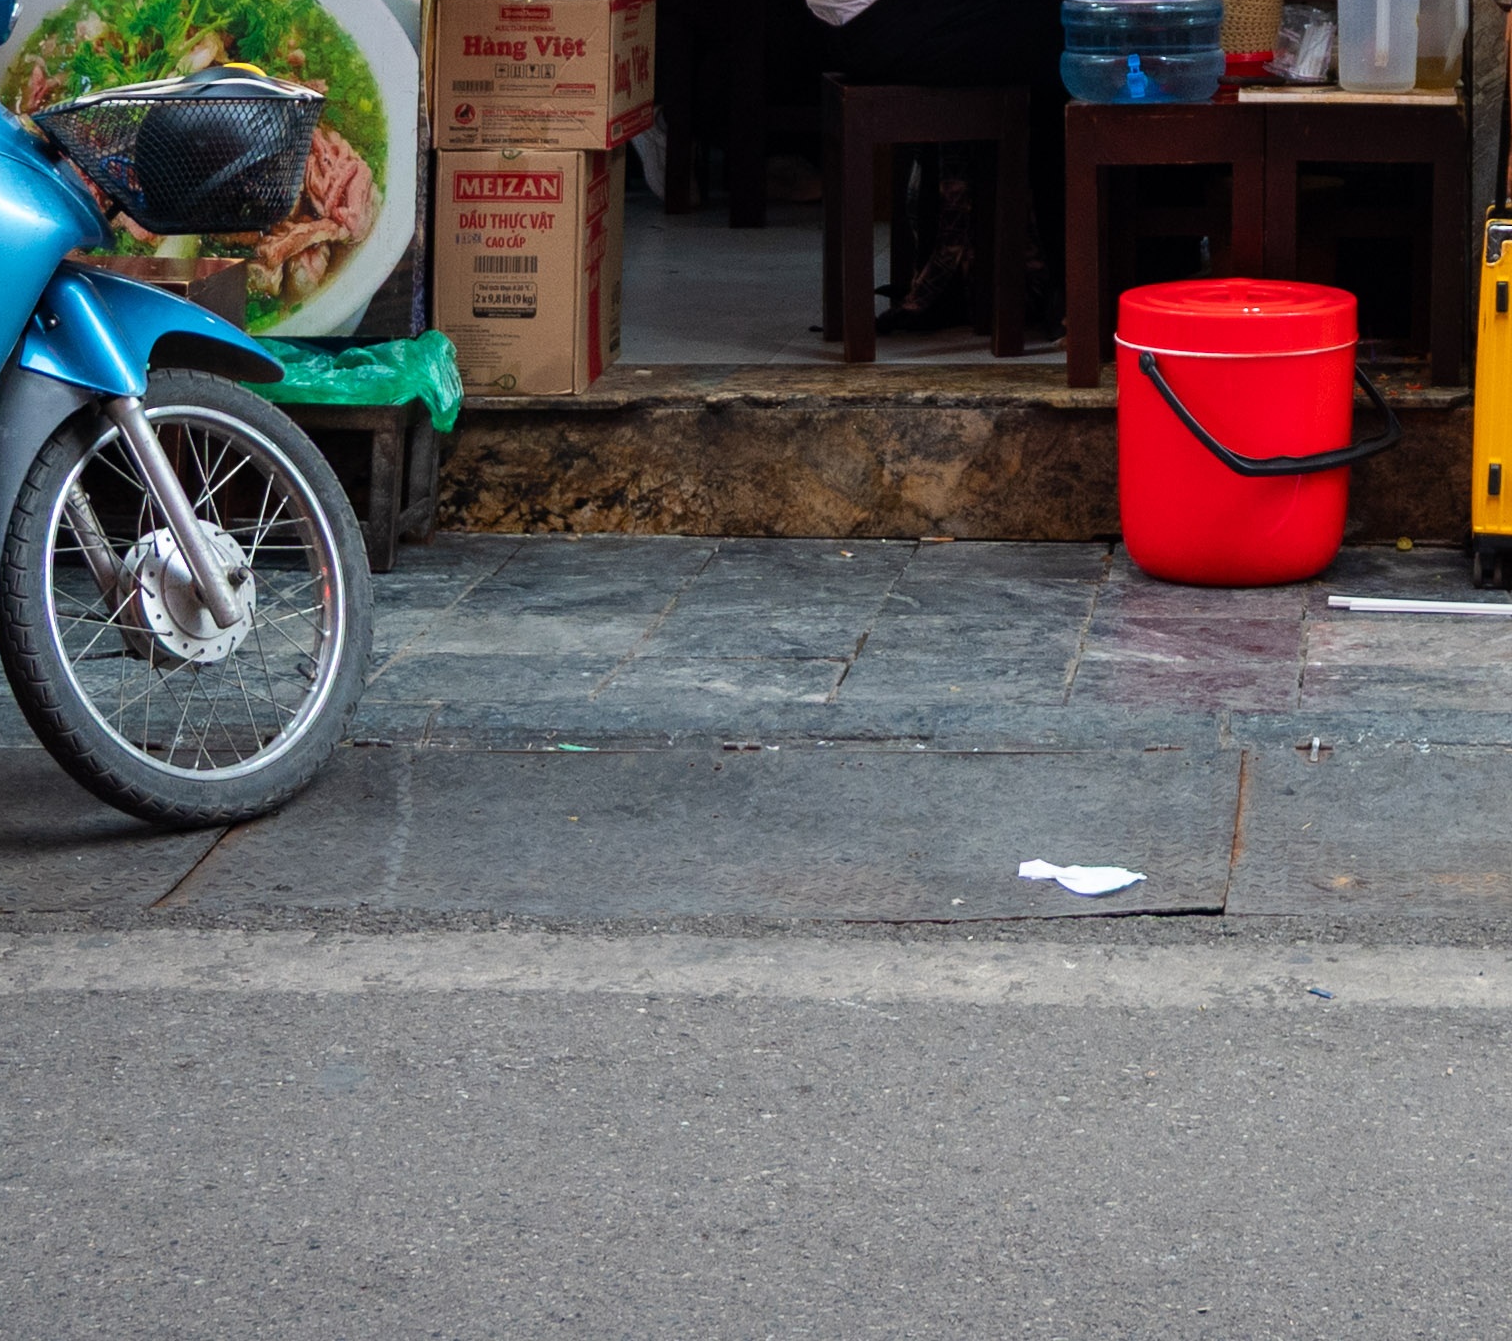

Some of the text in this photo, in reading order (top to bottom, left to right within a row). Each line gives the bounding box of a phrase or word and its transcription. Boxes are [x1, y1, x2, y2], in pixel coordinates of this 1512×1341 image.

[462, 35, 587, 62] Hàng Việt
[459, 177, 558, 197] MEIZAN
[459, 209, 556, 234] DẦU THỰC VẬT
[485, 236, 505, 248] CAO
[507, 233, 527, 248] CẤP
